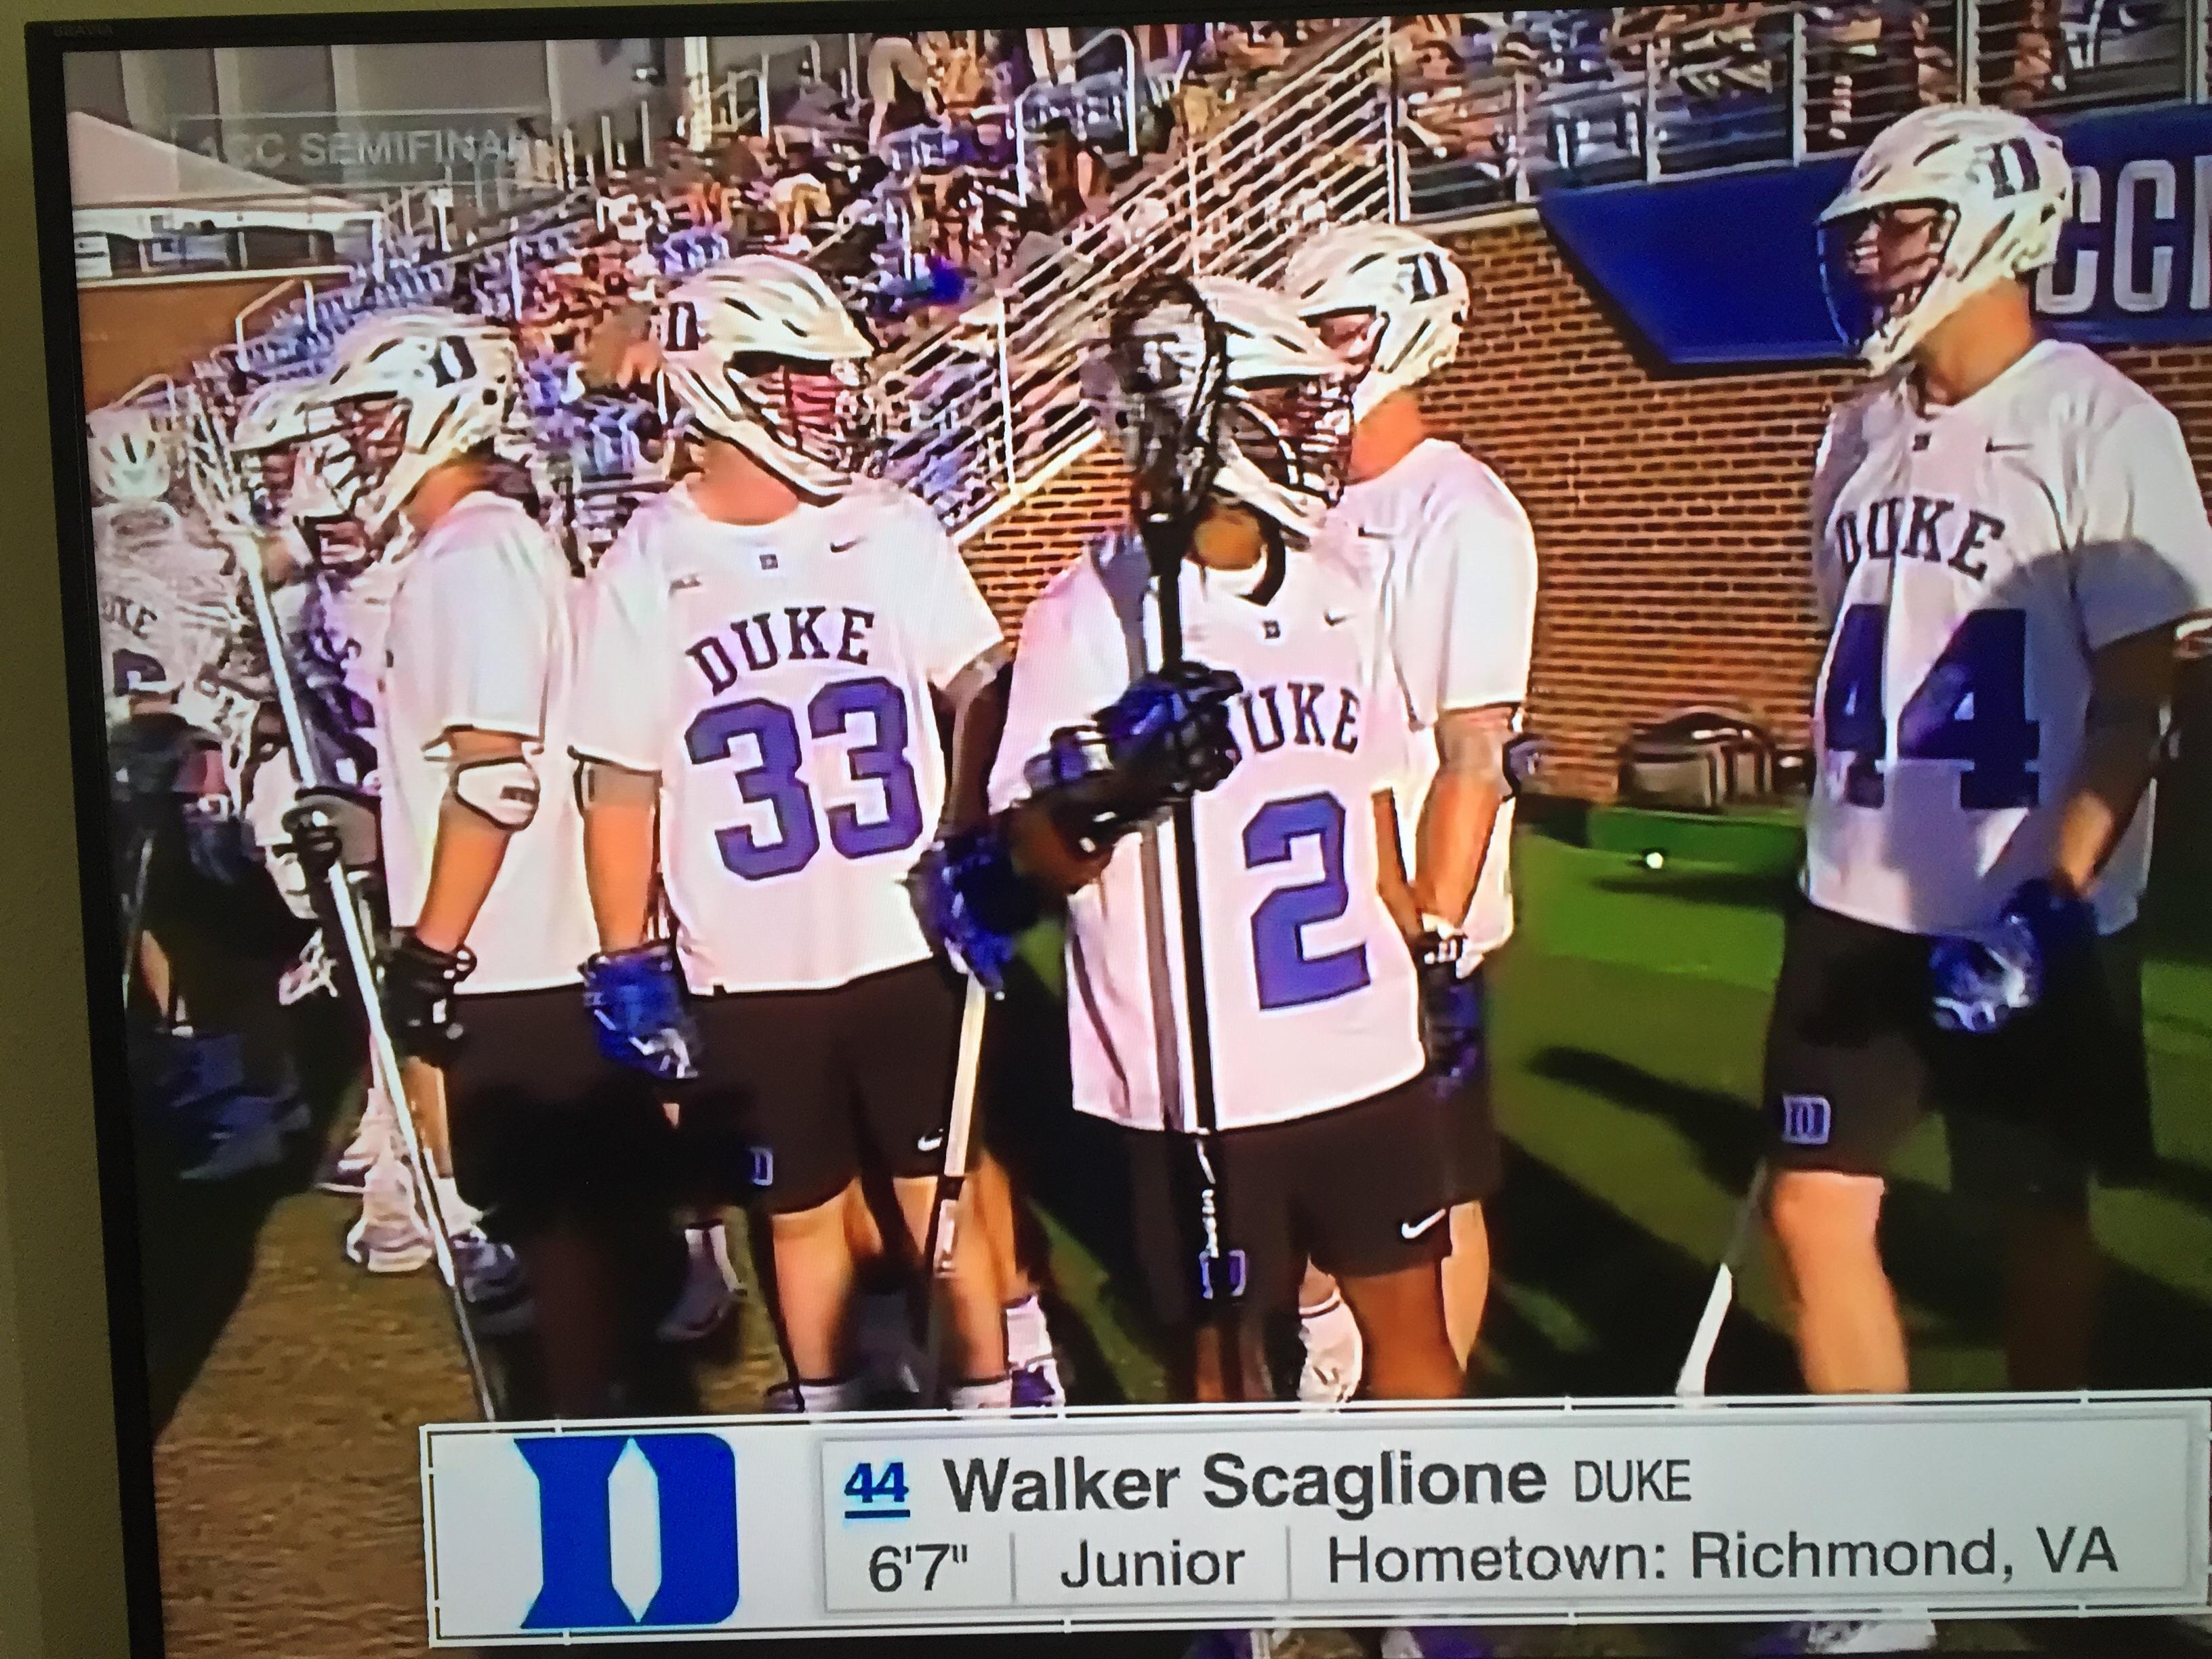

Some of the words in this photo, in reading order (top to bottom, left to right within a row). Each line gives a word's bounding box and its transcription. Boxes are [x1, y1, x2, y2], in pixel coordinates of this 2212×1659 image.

[1835, 496, 2006, 582] DUKE
[685, 606, 875, 696] DUKE
[1237, 680, 1360, 754] UKE
[1825, 604, 2040, 810] 44
[684, 676, 923, 881] 33
[1242, 791, 1371, 1010] 2
[844, 1461, 909, 1504] 44
[943, 1455, 1181, 1513] Walker
[1204, 1450, 1547, 1521] Scaglione
[1575, 1459, 1692, 1503] DUKE
[869, 1543, 968, 1593] 6'7"
[1061, 1538, 1246, 1588] Junior
[1329, 1534, 1665, 1584] Hometown:
[1692, 1527, 2013, 1584] Richmond,
[2036, 1525, 2119, 1574] VA
